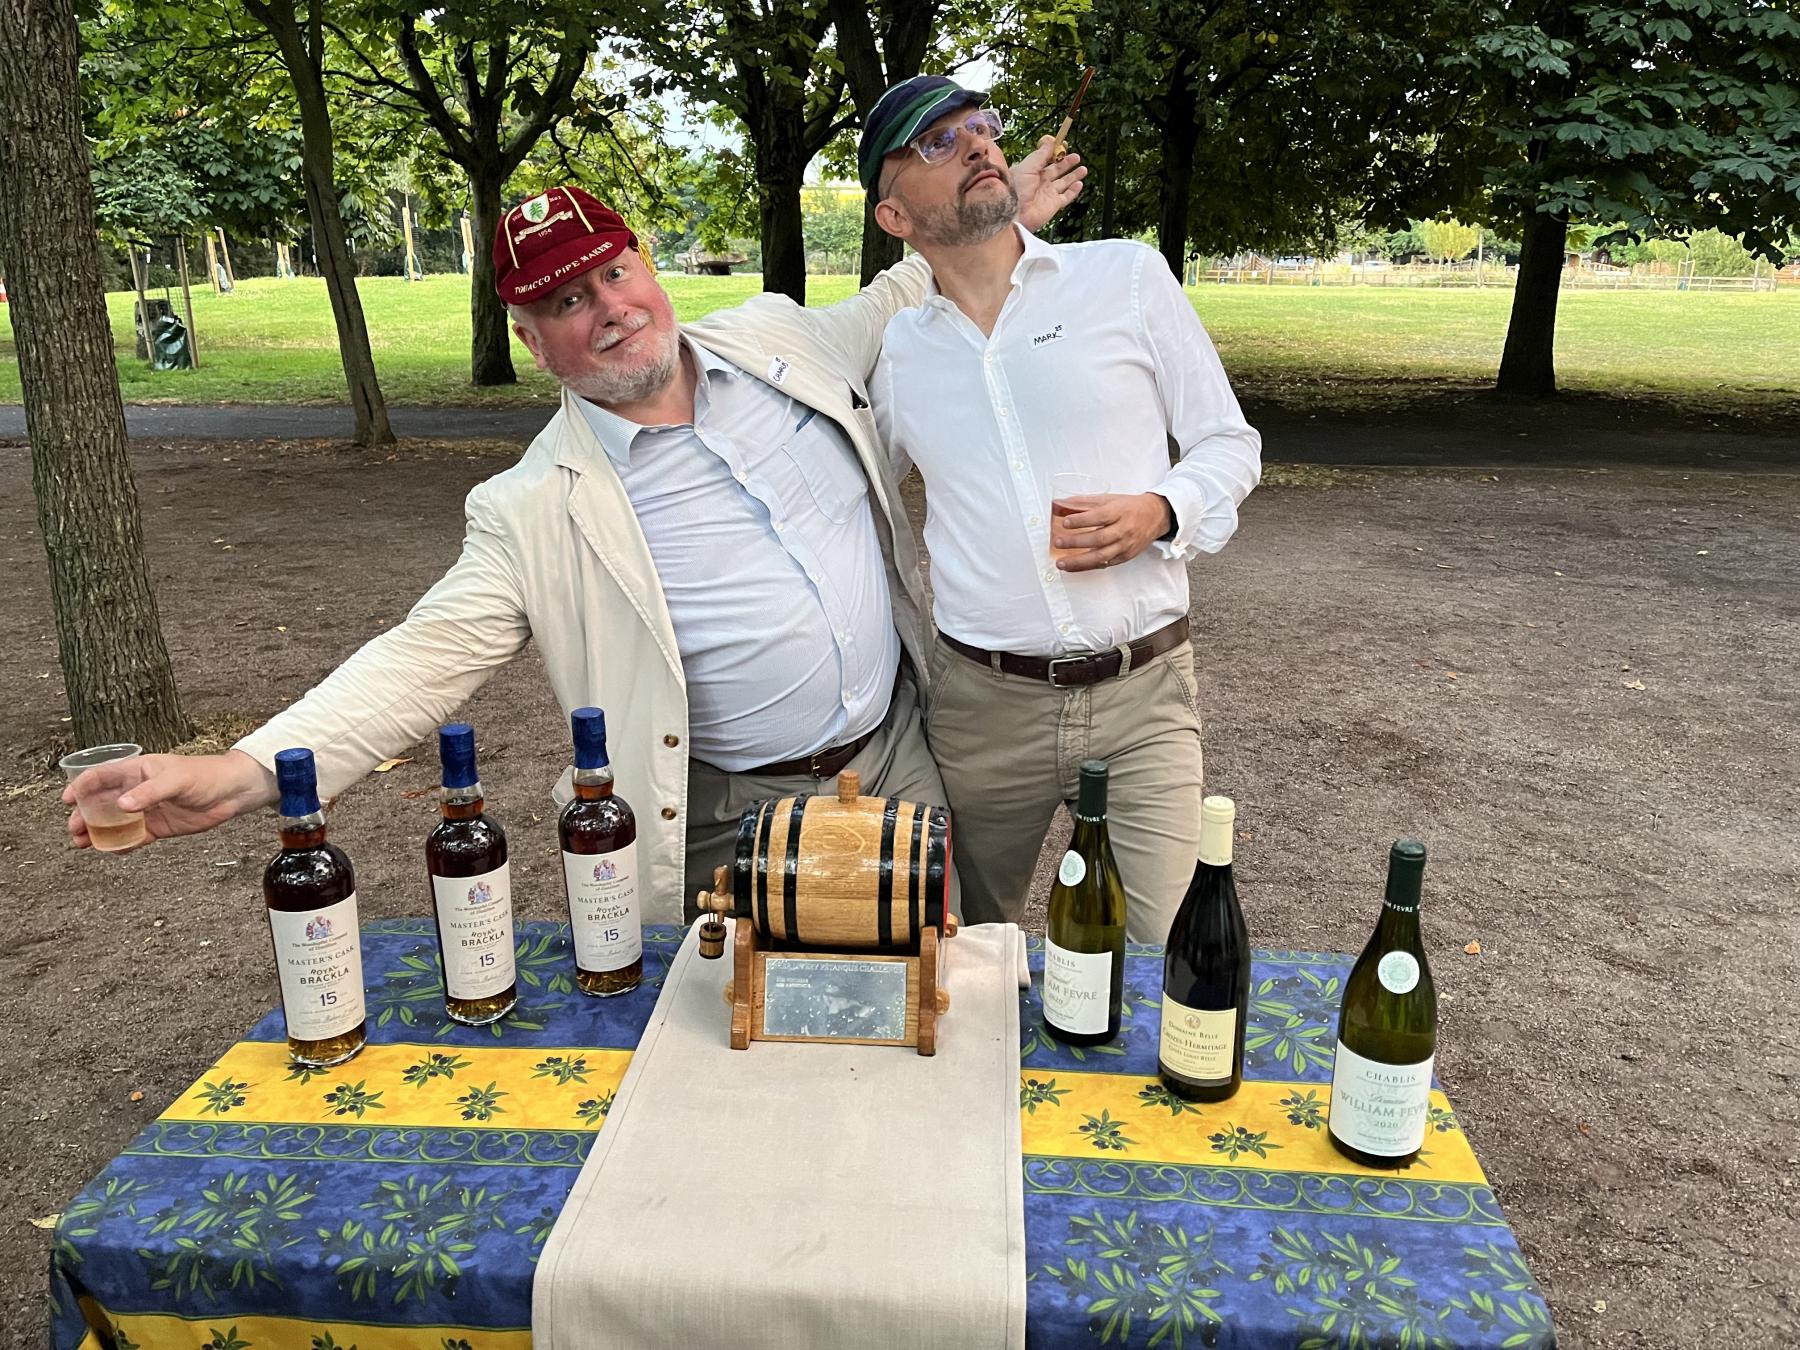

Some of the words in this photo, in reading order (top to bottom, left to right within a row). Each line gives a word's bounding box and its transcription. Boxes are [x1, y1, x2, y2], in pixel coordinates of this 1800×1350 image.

[514, 275, 551, 295] TOBACCO
[554, 260, 581, 278] PIPE
[580, 241, 614, 263] MAKERS
[1034, 332, 1062, 346] MARK
[577, 893, 616, 904] MASTER'S
[617, 887, 634, 899] CASK
[587, 907, 630, 921] BRACKLA
[596, 904, 621, 914] ROYAL
[1393, 904, 1413, 913] FEVRE
[450, 918, 491, 929] MASTER'S
[493, 910, 509, 922] CASK
[461, 930, 505, 947] BRACKLA
[471, 927, 497, 938] ROYAL
[603, 928, 619, 942] 15
[287, 955, 333, 966] MASTER'S
[335, 945, 354, 958] CASK
[479, 952, 495, 968] 15
[300, 967, 349, 985] BRACKLA
[310, 965, 339, 975] ROYAL
[320, 991, 338, 1007] 15
[1063, 987, 1097, 1000] FEVRE
[1366, 1071, 1416, 1084] CHABLIS
[1340, 1089, 1395, 1117] WILLIAM
[1373, 1120, 1399, 1129] 2020
